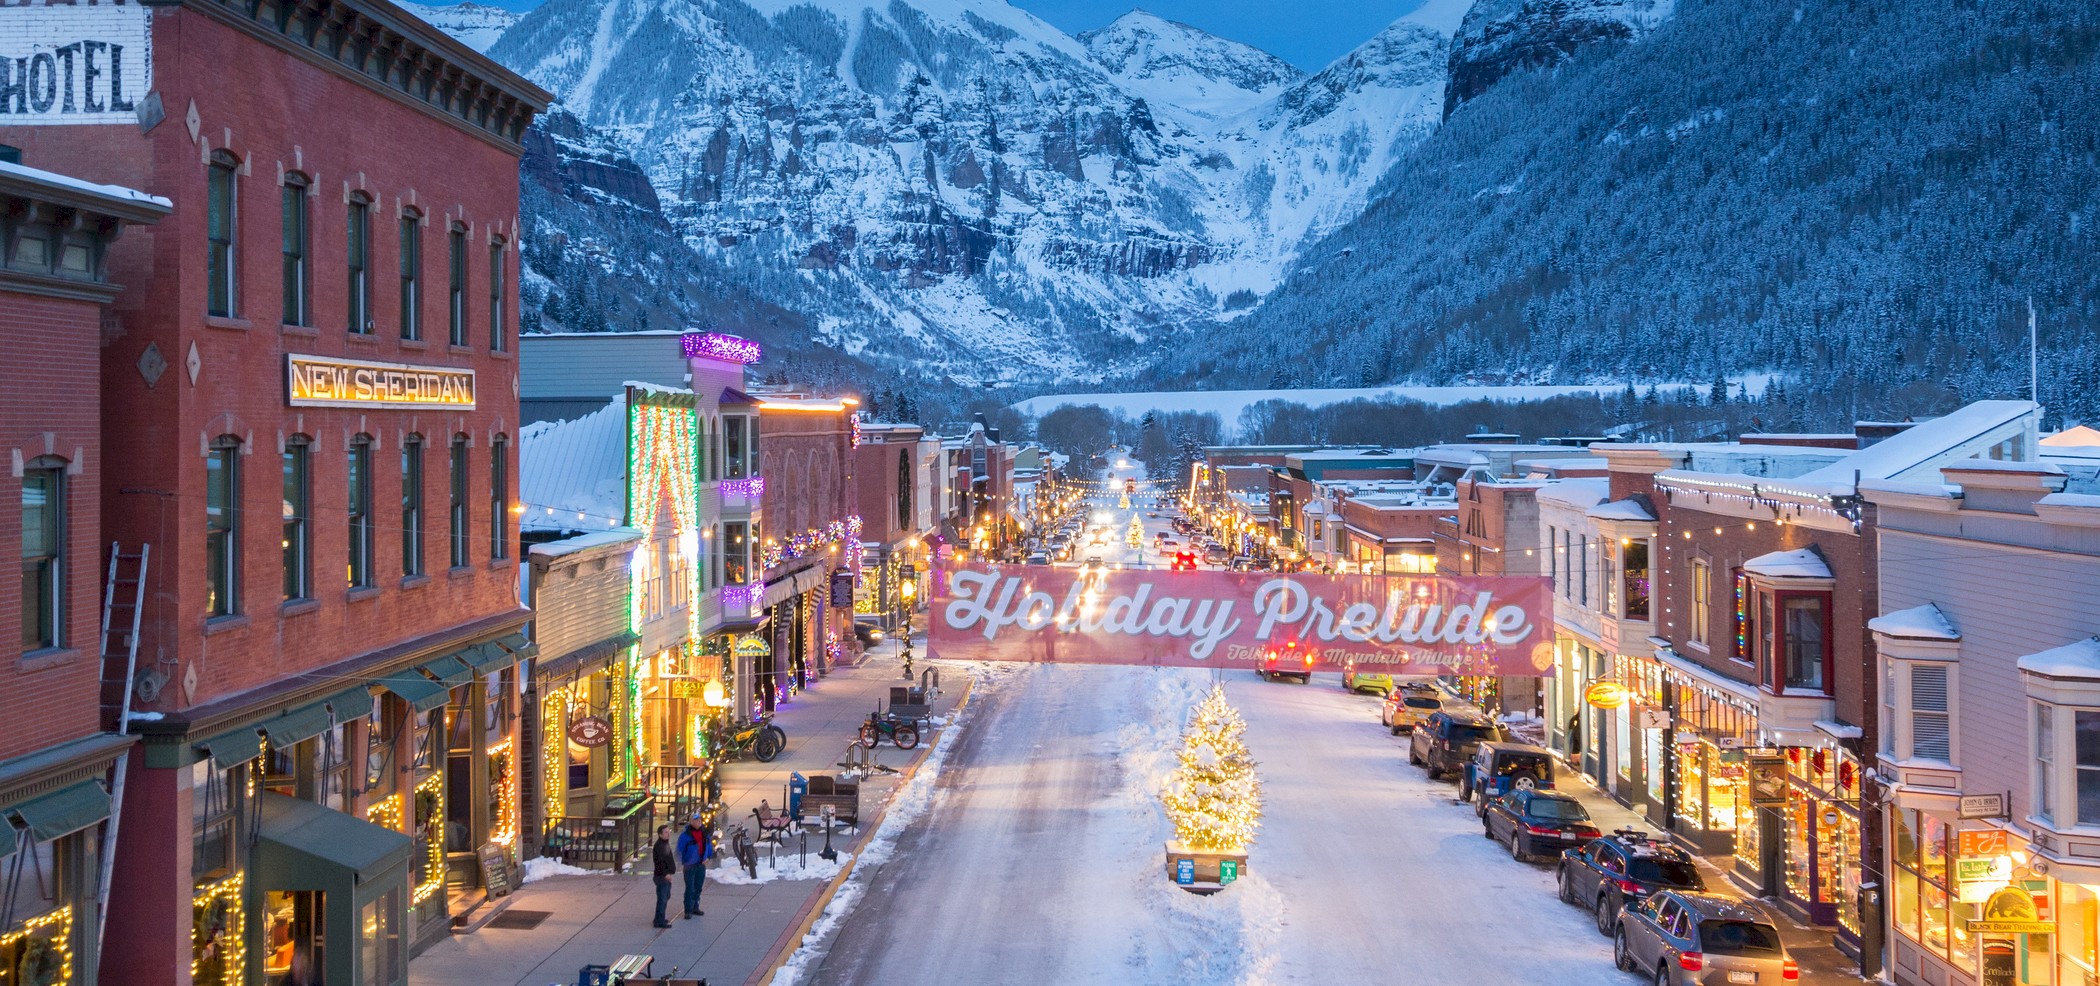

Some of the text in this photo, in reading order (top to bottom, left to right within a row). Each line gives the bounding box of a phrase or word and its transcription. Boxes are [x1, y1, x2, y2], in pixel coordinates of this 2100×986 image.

[0, 40, 133, 114] HOTEL
[292, 364, 470, 402] NEW SHERIDAN
[946, 570, 1534, 660] Holiday Prelude
[1227, 644, 1302, 661] Tellide
[1324, 648, 1409, 666] Mountain
[1412, 649, 1475, 672] Village
[577, 736, 597, 745] COFFEE
[1871, 893, 1877, 902] P
[1970, 923, 1991, 931] BLACK
